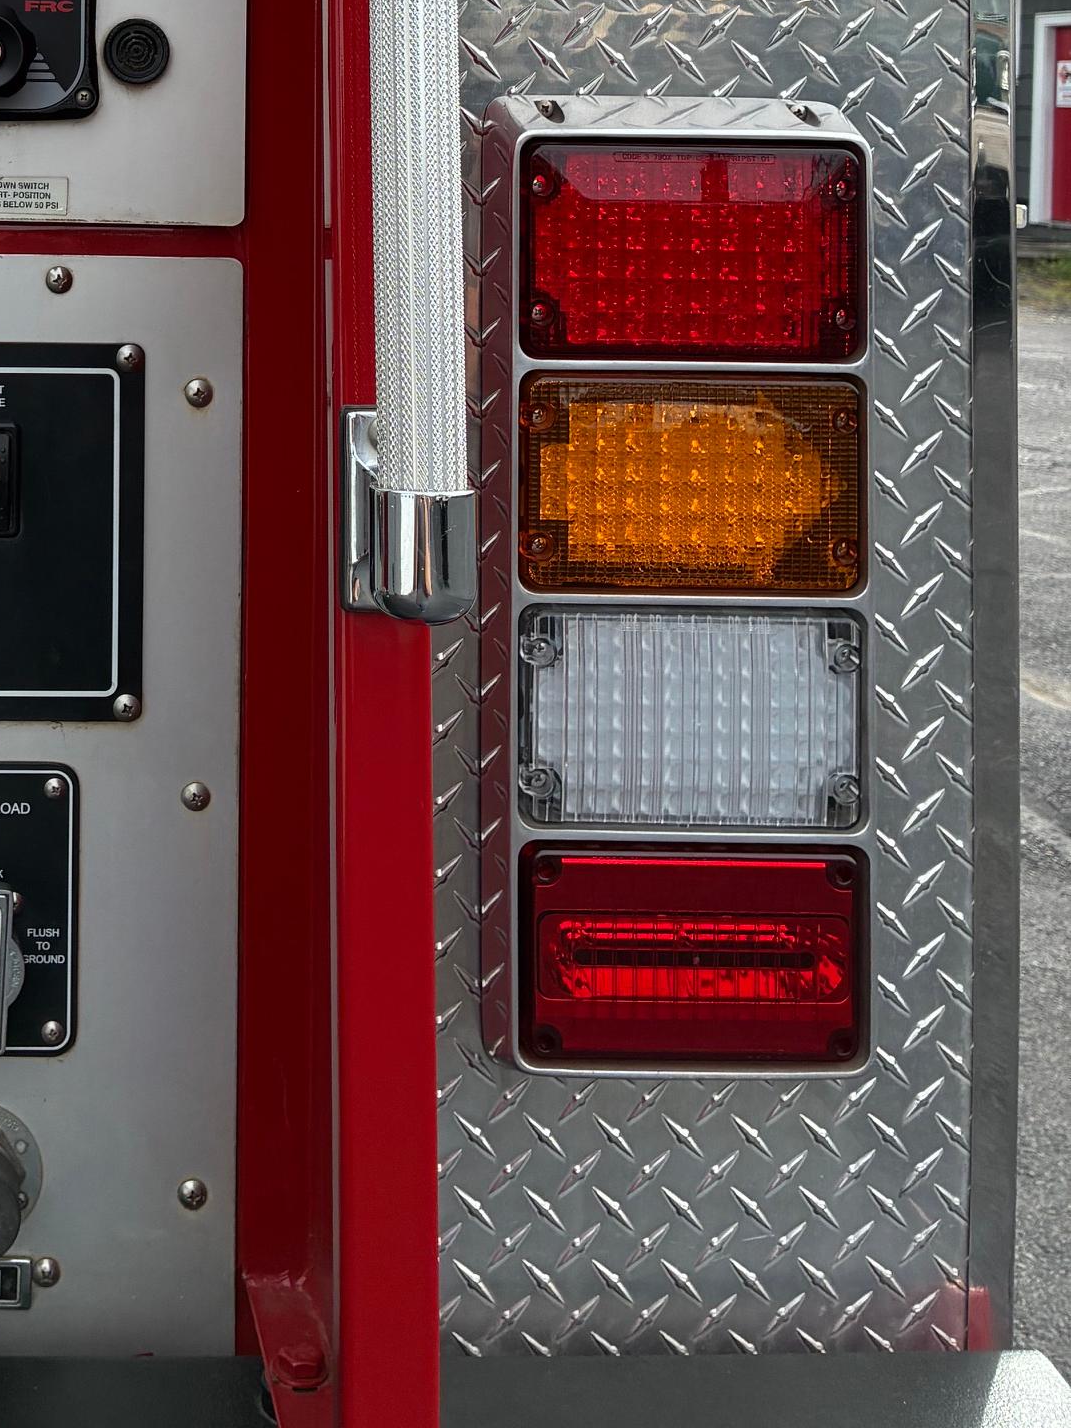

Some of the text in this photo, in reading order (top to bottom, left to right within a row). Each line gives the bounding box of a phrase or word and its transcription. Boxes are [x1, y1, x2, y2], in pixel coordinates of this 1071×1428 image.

[25, 0, 73, 12] FRC
[27, 929, 59, 937] FLUSH
[36, 942, 50, 950] TO
[23, 955, 65, 964] GROUND
